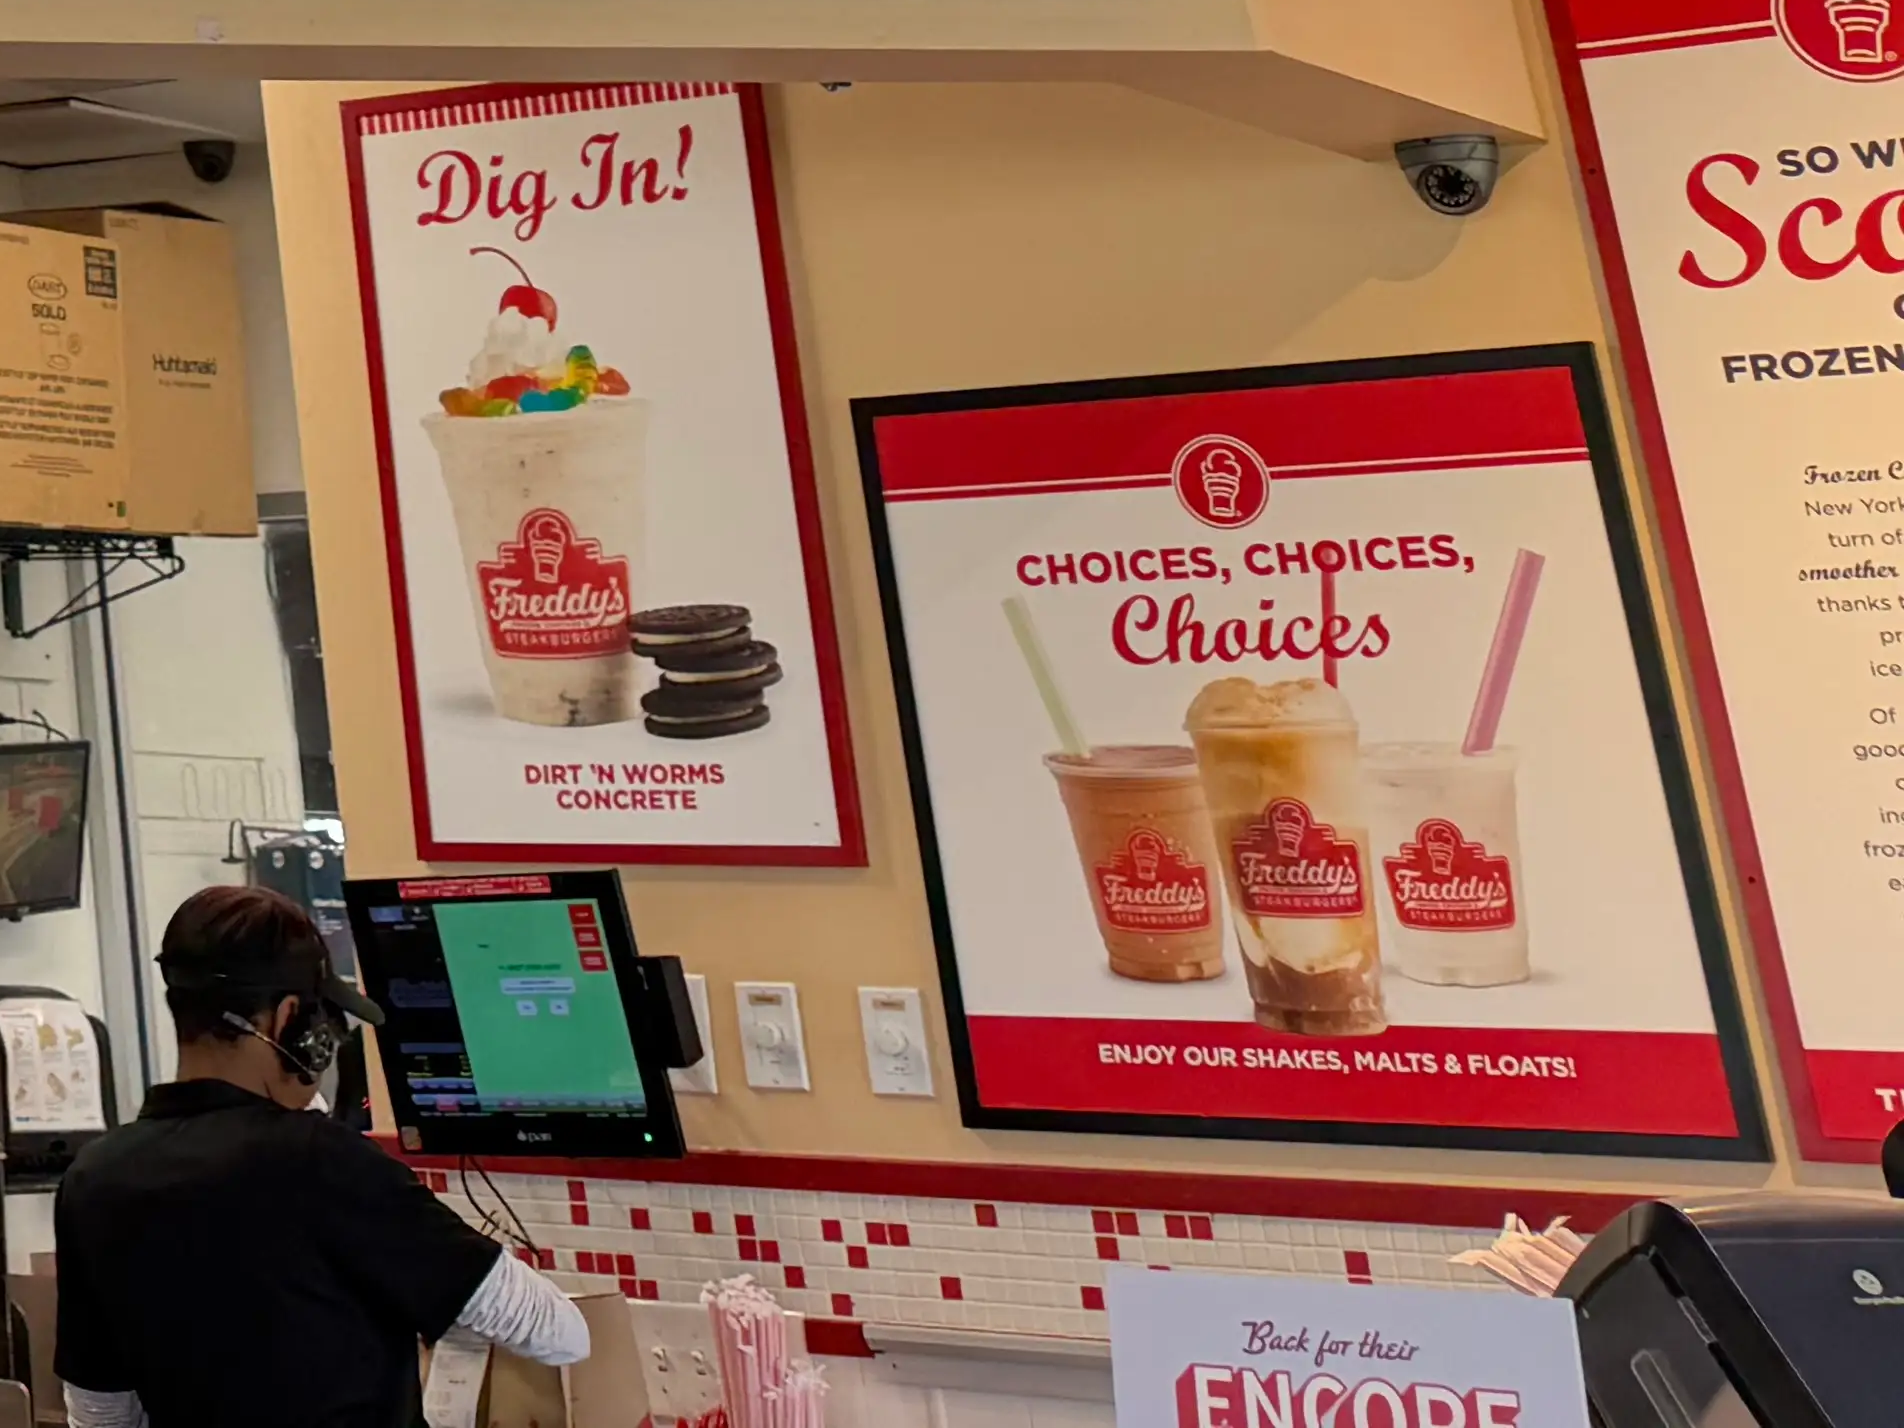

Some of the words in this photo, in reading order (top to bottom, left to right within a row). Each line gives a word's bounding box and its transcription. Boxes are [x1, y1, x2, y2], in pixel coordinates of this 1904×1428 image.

[1777, 146, 1838, 176] SO
[418, 151, 557, 241] Dig
[572, 124, 692, 209] In!
[1805, 465, 1881, 484] Frozen
[1805, 501, 1852, 516] New
[1828, 533, 1874, 547] turn
[1881, 529, 1902, 545] of
[1017, 547, 1231, 586] CHOICES,
[1244, 535, 1474, 576] CHOICES,
[1799, 560, 1898, 581] smoother
[490, 578, 626, 629] Freddy's
[1817, 596, 1891, 612] thanks
[1112, 593, 1391, 666] Choices
[1870, 708, 1895, 724] Of
[525, 765, 582, 784] DIRT
[622, 764, 724, 784] WORMS
[557, 790, 697, 809] CONCRETE
[1240, 850, 1358, 893] Freddy's
[1106, 872, 1207, 910] Freddy's
[1396, 870, 1506, 909] Freddy's
[1099, 1044, 1176, 1064] ENJOY
[1184, 1047, 1237, 1066] OUR
[1243, 1048, 1348, 1073] SHAKES,
[1354, 1051, 1438, 1073] MALTS
[1444, 1053, 1463, 1074] &
[1468, 1055, 1576, 1077] FLOATS!
[1242, 1321, 1309, 1355] Back
[1314, 1331, 1353, 1367] for
[1359, 1331, 1419, 1360] their
